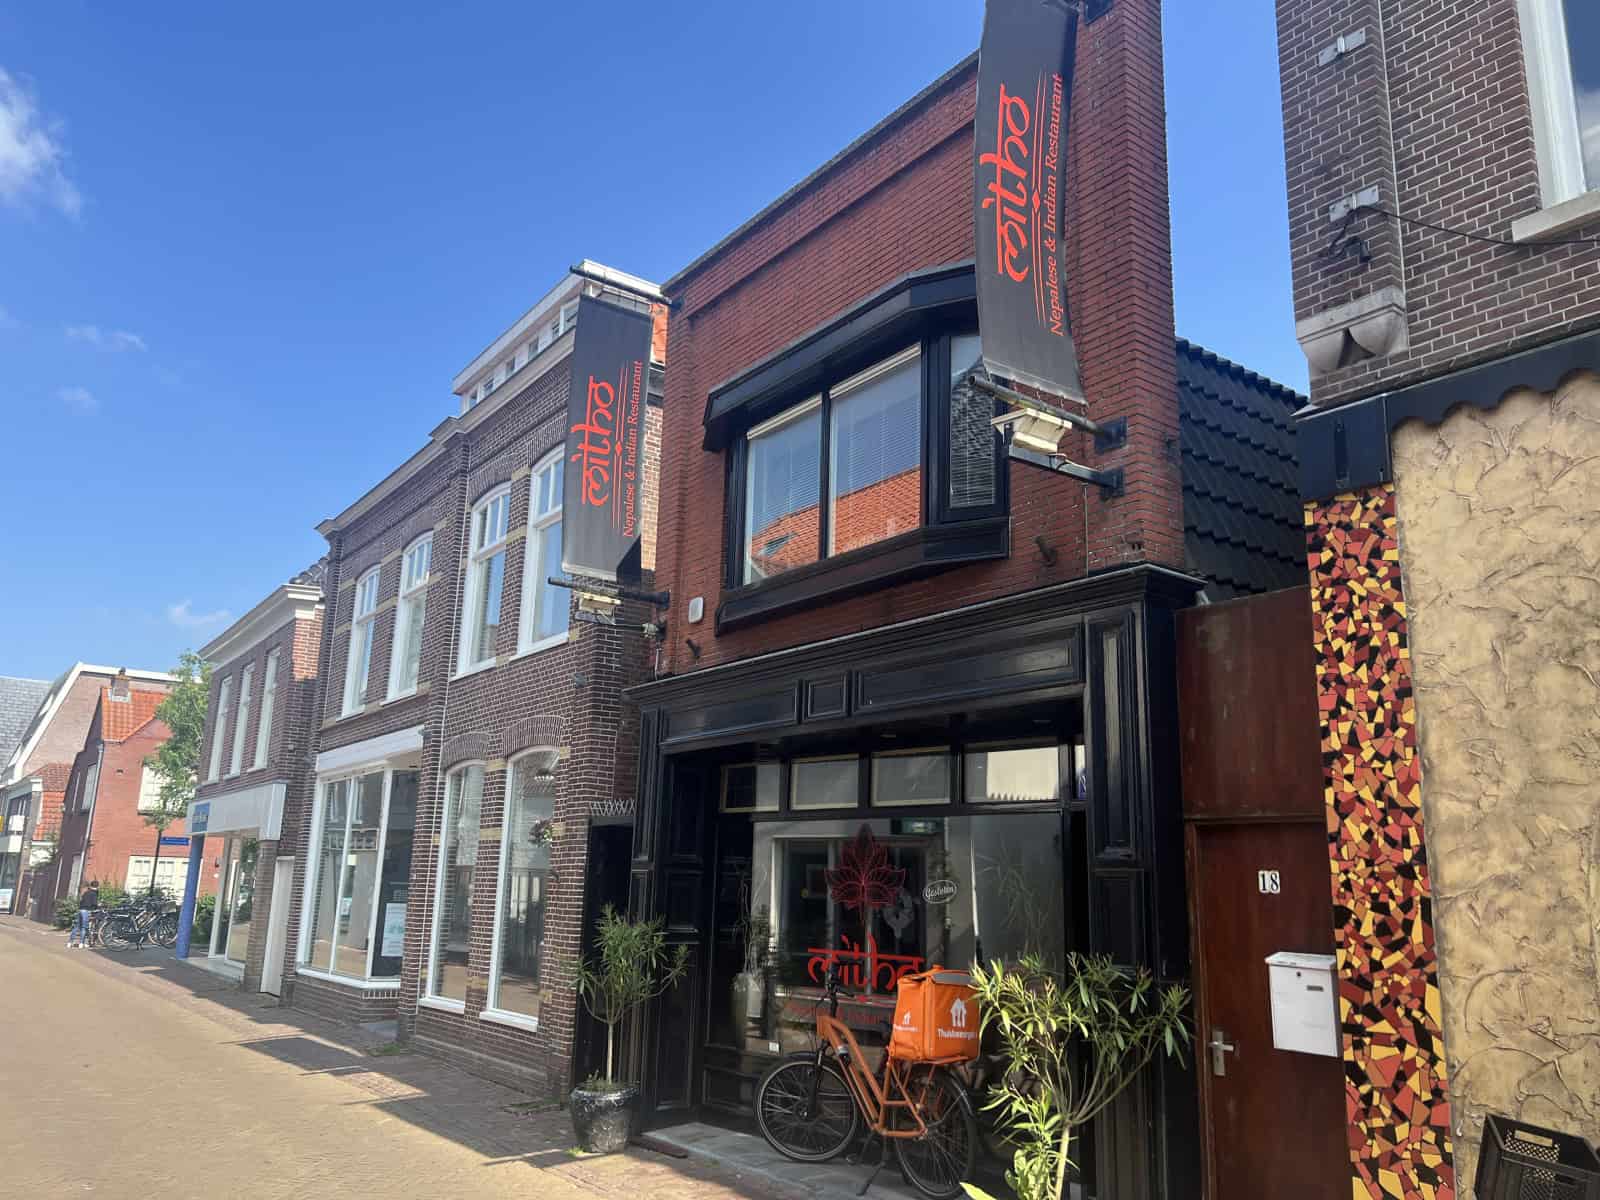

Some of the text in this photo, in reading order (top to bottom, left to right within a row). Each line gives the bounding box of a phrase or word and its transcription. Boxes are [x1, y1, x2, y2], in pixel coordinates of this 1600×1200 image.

[1043, 73, 1065, 337] Nepalese & Indian Restaurant
[623, 360, 643, 537] Nepalese & Indian Restaurant
[1260, 871, 1280, 893] 18
